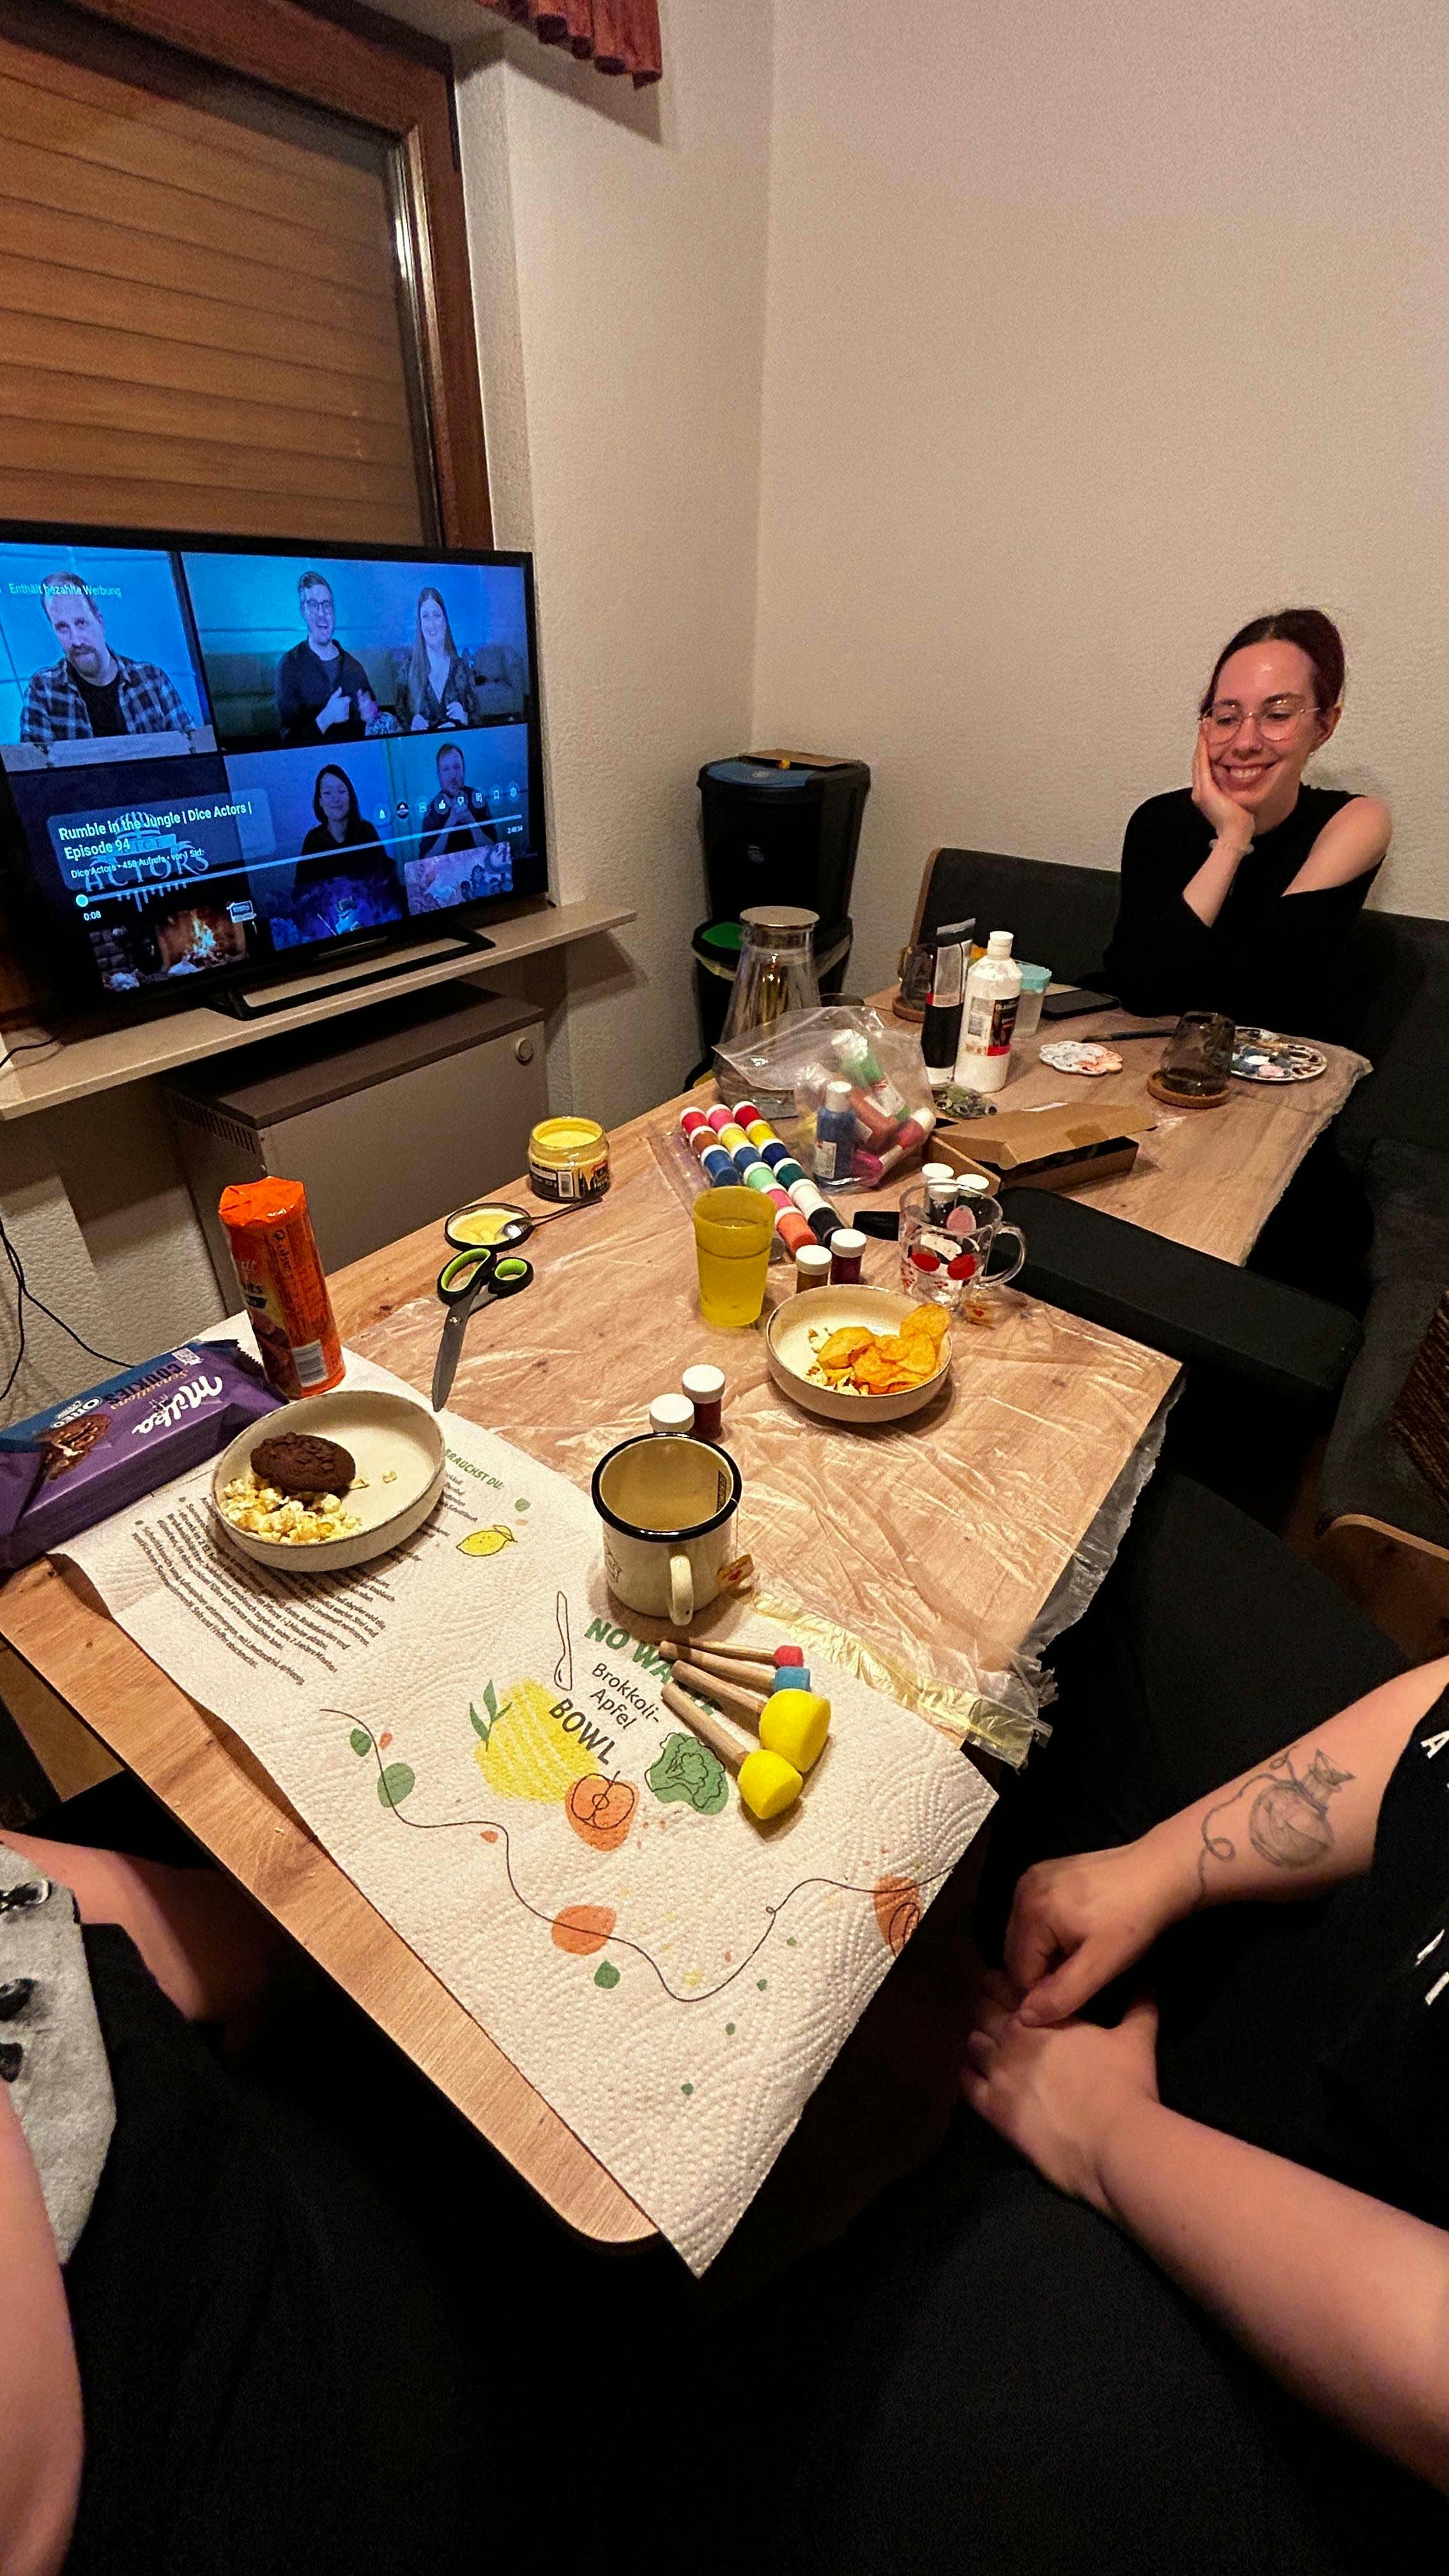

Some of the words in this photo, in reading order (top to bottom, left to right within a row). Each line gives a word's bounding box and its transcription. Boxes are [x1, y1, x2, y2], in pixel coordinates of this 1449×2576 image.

[9, 583, 43, 594] Enthält
[43, 584, 82, 595] bezahlte
[82, 585, 122, 597] Werbung
[58, 822, 106, 841] Rumble
[107, 820, 120, 833] in
[121, 817, 141, 831] the
[142, 812, 181, 828] Jungle
[187, 808, 211, 821] Dice
[214, 804, 247, 818] Actors
[64, 841, 113, 861] Episode
[114, 838, 131, 851] 94
[91, 865, 116, 875] Actors
[53, 1398, 100, 1427] OREO
[132, 1374, 222, 1434] Milka
[181, 1552, 195, 1570] eine
[584, 1617, 631, 1651] NO
[589, 1688, 637, 1730] Apfel
[592, 1662, 659, 1723] Brokkoli-
[548, 1698, 616, 1765] BOWL
